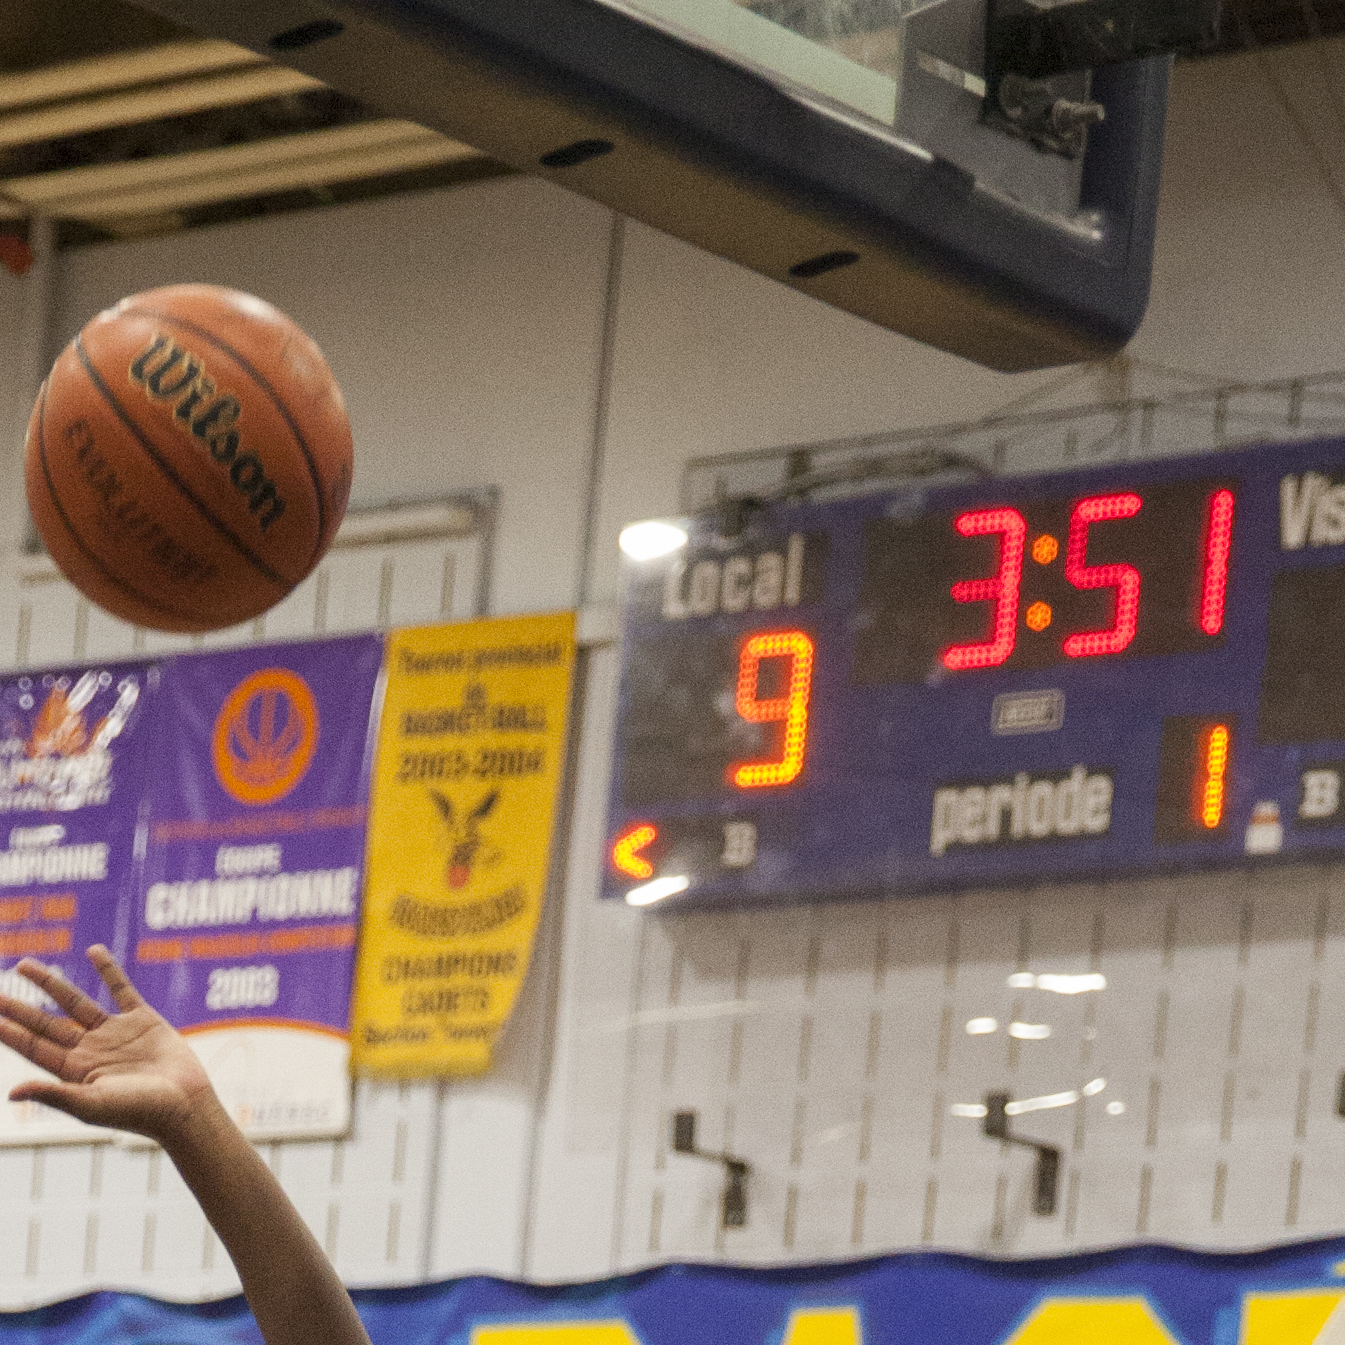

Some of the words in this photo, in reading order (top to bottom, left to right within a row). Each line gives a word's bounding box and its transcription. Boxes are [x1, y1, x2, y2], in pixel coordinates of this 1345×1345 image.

[128, 330, 286, 533] Wilson
[661, 533, 807, 621] Local
[941, 488, 1237, 673] 3:51
[731, 629, 815, 789] 9
[1202, 724, 1231, 830] 1
